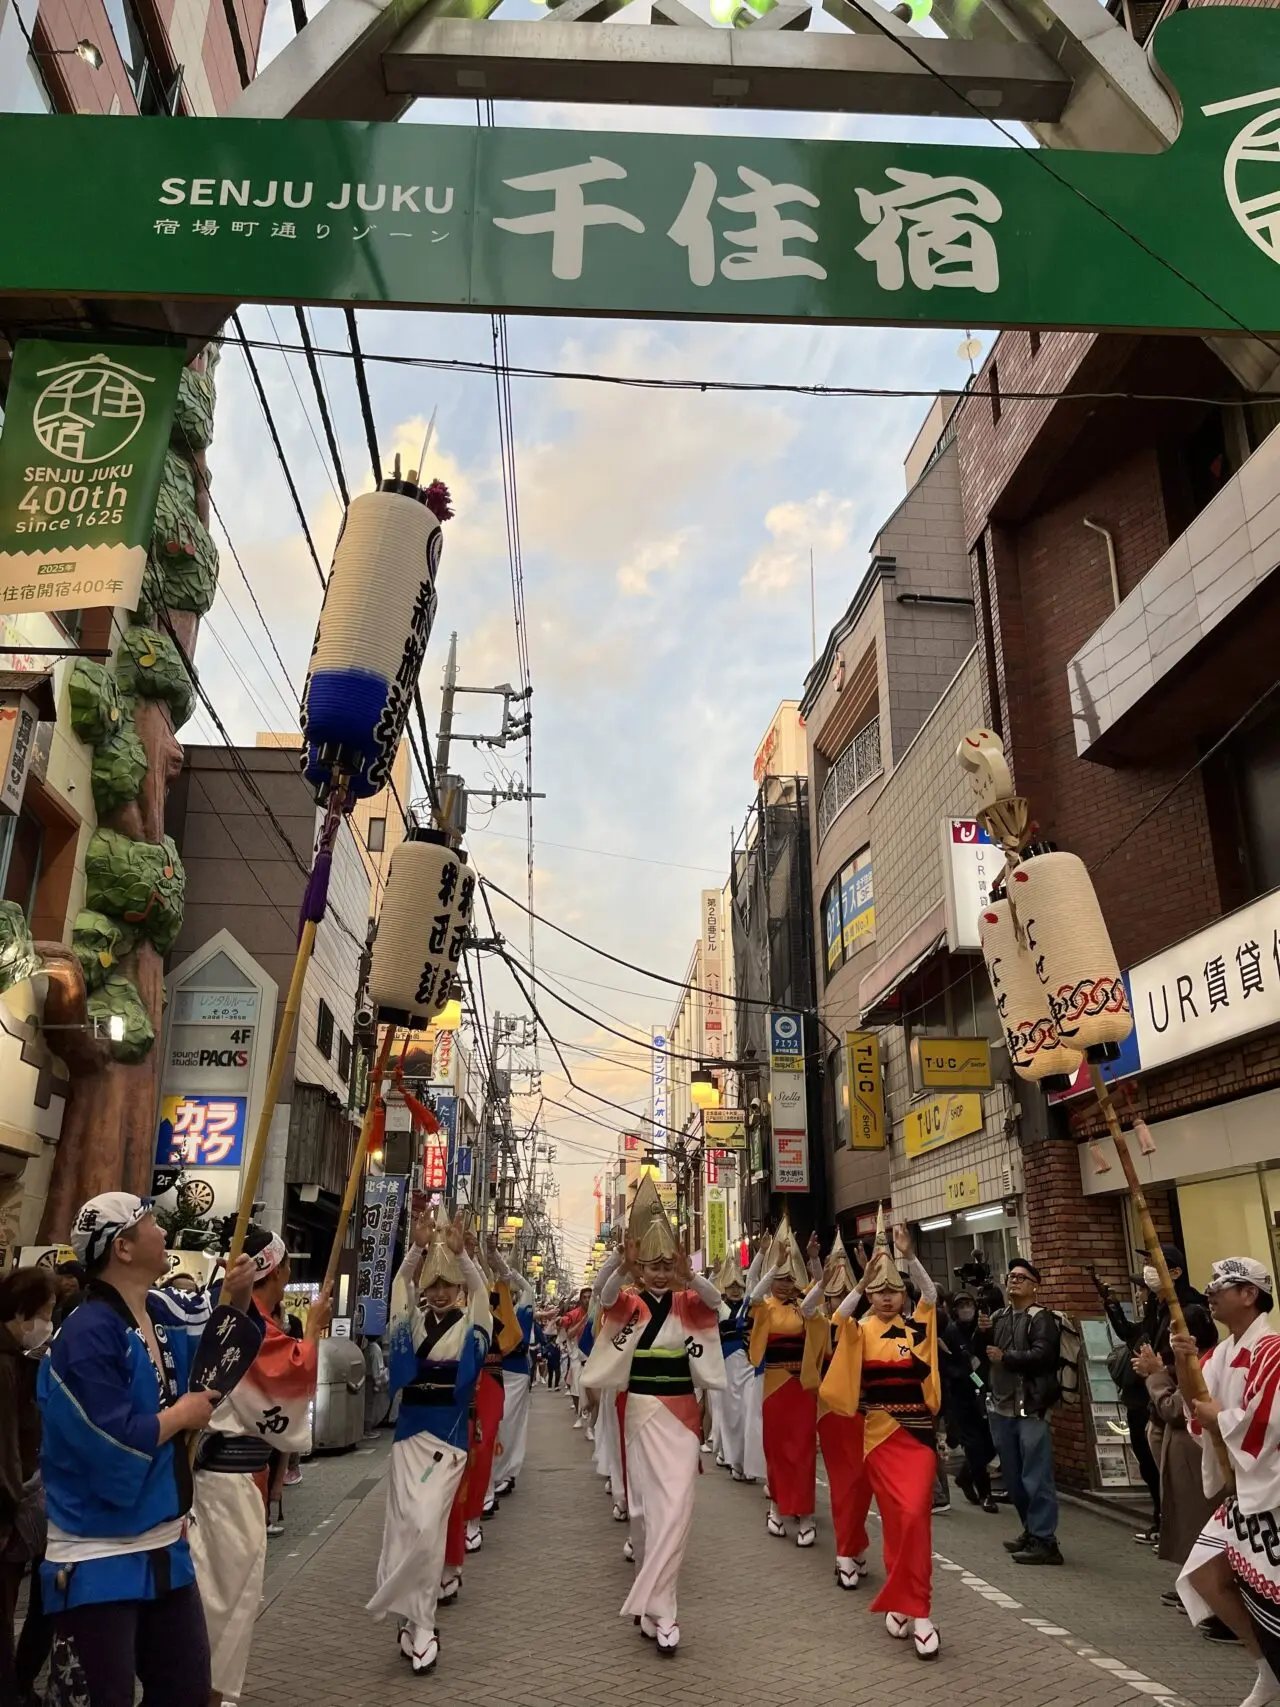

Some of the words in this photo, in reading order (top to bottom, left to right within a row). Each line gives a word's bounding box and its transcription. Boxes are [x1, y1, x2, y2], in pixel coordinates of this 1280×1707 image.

[158, 177, 313, 209] SENJU
[327, 182, 454, 214] JUKU
[153, 219, 451, 244] 宿場町通りゾーン
[493, 156, 1002, 293] 千住宿
[23, 466, 84, 483] SENJU
[88, 463, 133, 482] JUKU
[18, 481, 127, 515] 400th
[15, 517, 70, 533] since
[76, 509, 123, 528] 1625
[0, 579, 124, 602] 住宿開宿400年
[230, 1029, 251, 1044] 4F
[172, 1050, 200, 1058] sound
[200, 1049, 248, 1066] PACKS
[172, 1058, 199, 1067] studio
[653, 1055, 667, 1138] コンサートホール
[174, 1101, 238, 1137] カラ
[169, 1131, 235, 1164] オケ
[156, 1175, 172, 1186] 2F
